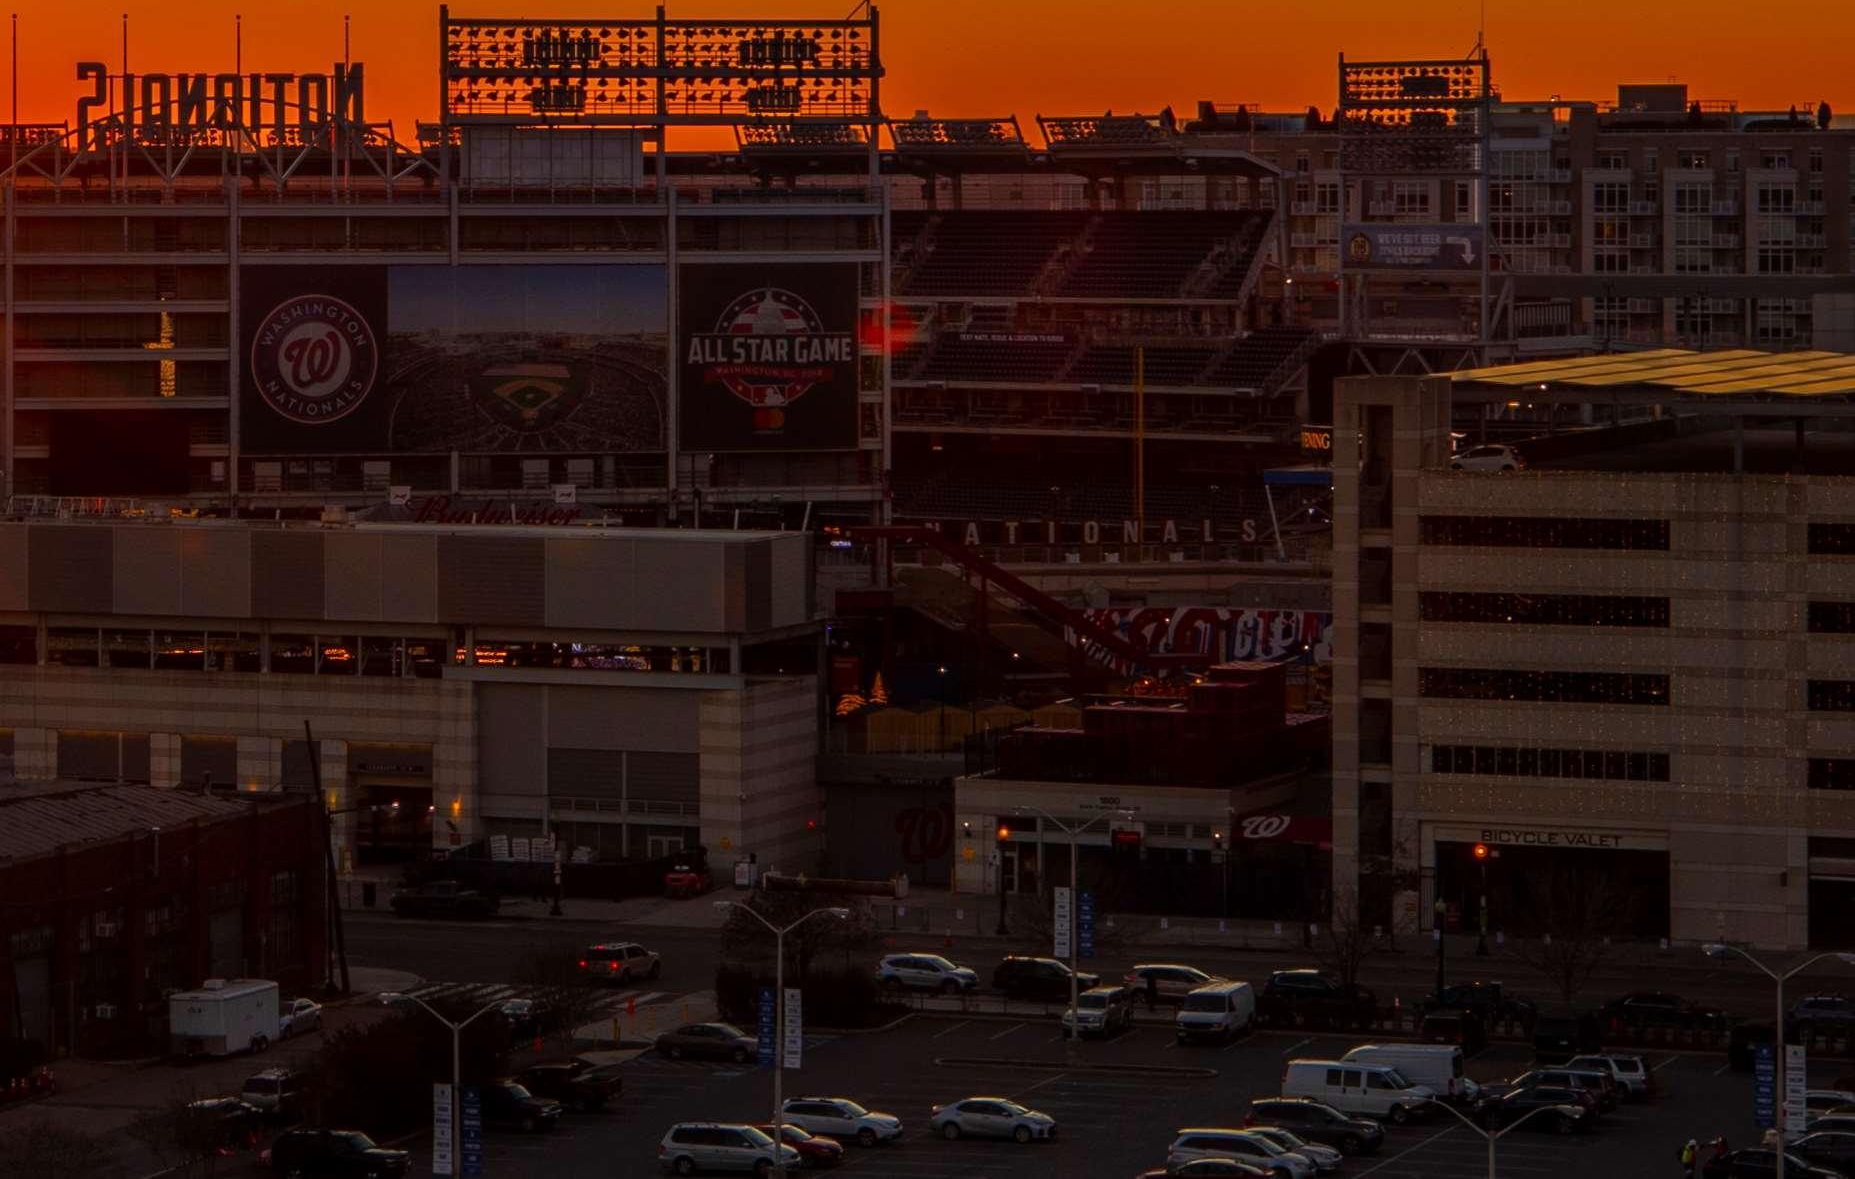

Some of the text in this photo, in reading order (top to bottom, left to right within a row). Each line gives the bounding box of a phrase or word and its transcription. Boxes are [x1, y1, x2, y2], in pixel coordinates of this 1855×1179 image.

[260, 303, 368, 348] WASHINGTON
[687, 336, 854, 364] ALL STAR GAME
[265, 380, 363, 415] NATIONALS
[1480, 829, 1624, 847] BICYCLE VALET
